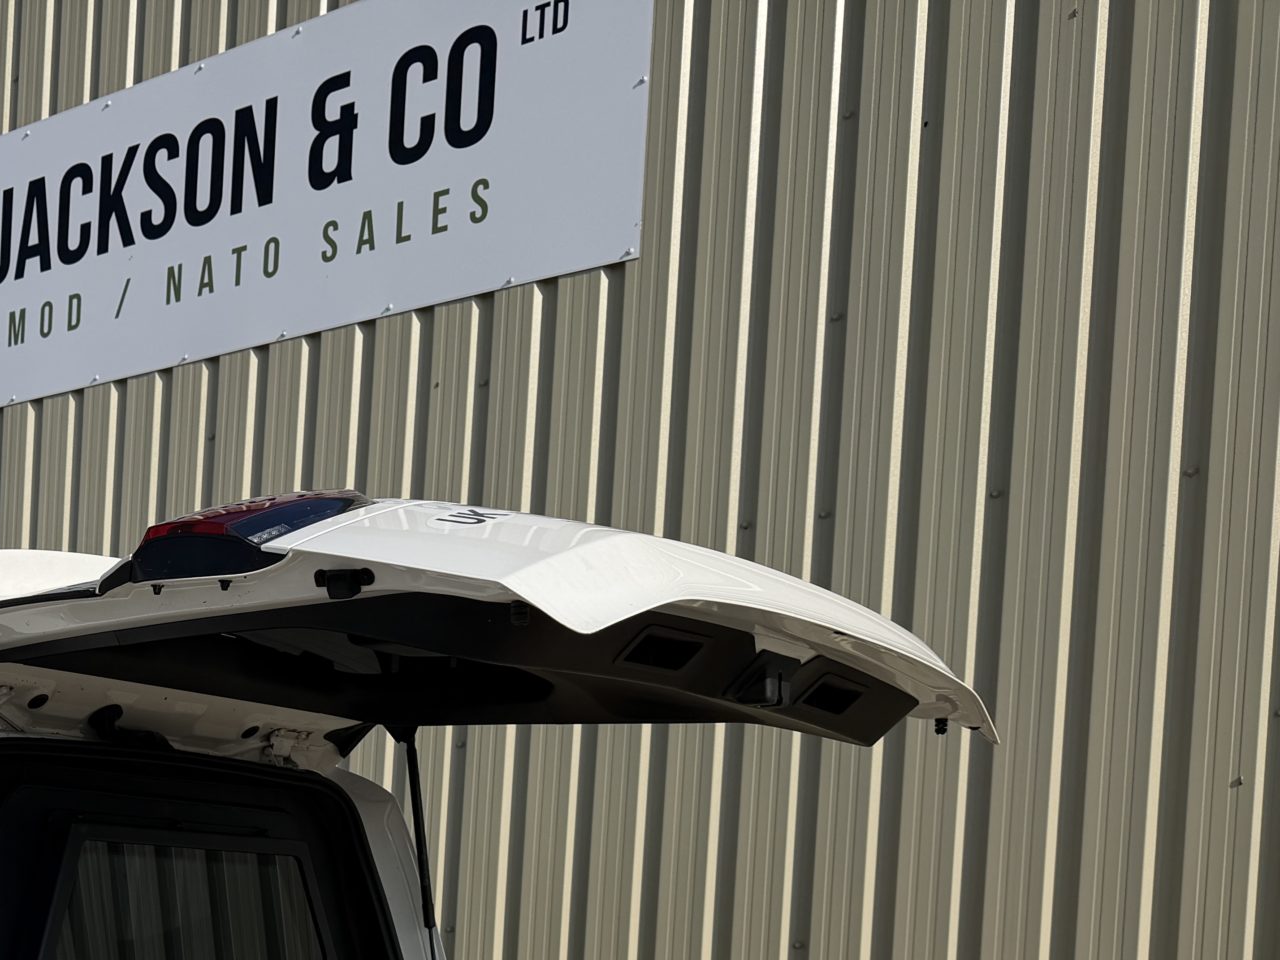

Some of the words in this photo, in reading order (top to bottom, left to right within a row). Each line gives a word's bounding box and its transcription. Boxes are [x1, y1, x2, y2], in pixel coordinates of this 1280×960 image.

[307, 70, 359, 192] &
[387, 24, 498, 166] CO
[520, 0, 570, 46] LTD
[7, 292, 82, 348] MOD
[114, 277, 131, 319] /
[165, 236, 280, 306] NATO
[321, 178, 490, 263] SALES
[435, 509, 510, 525] UK
